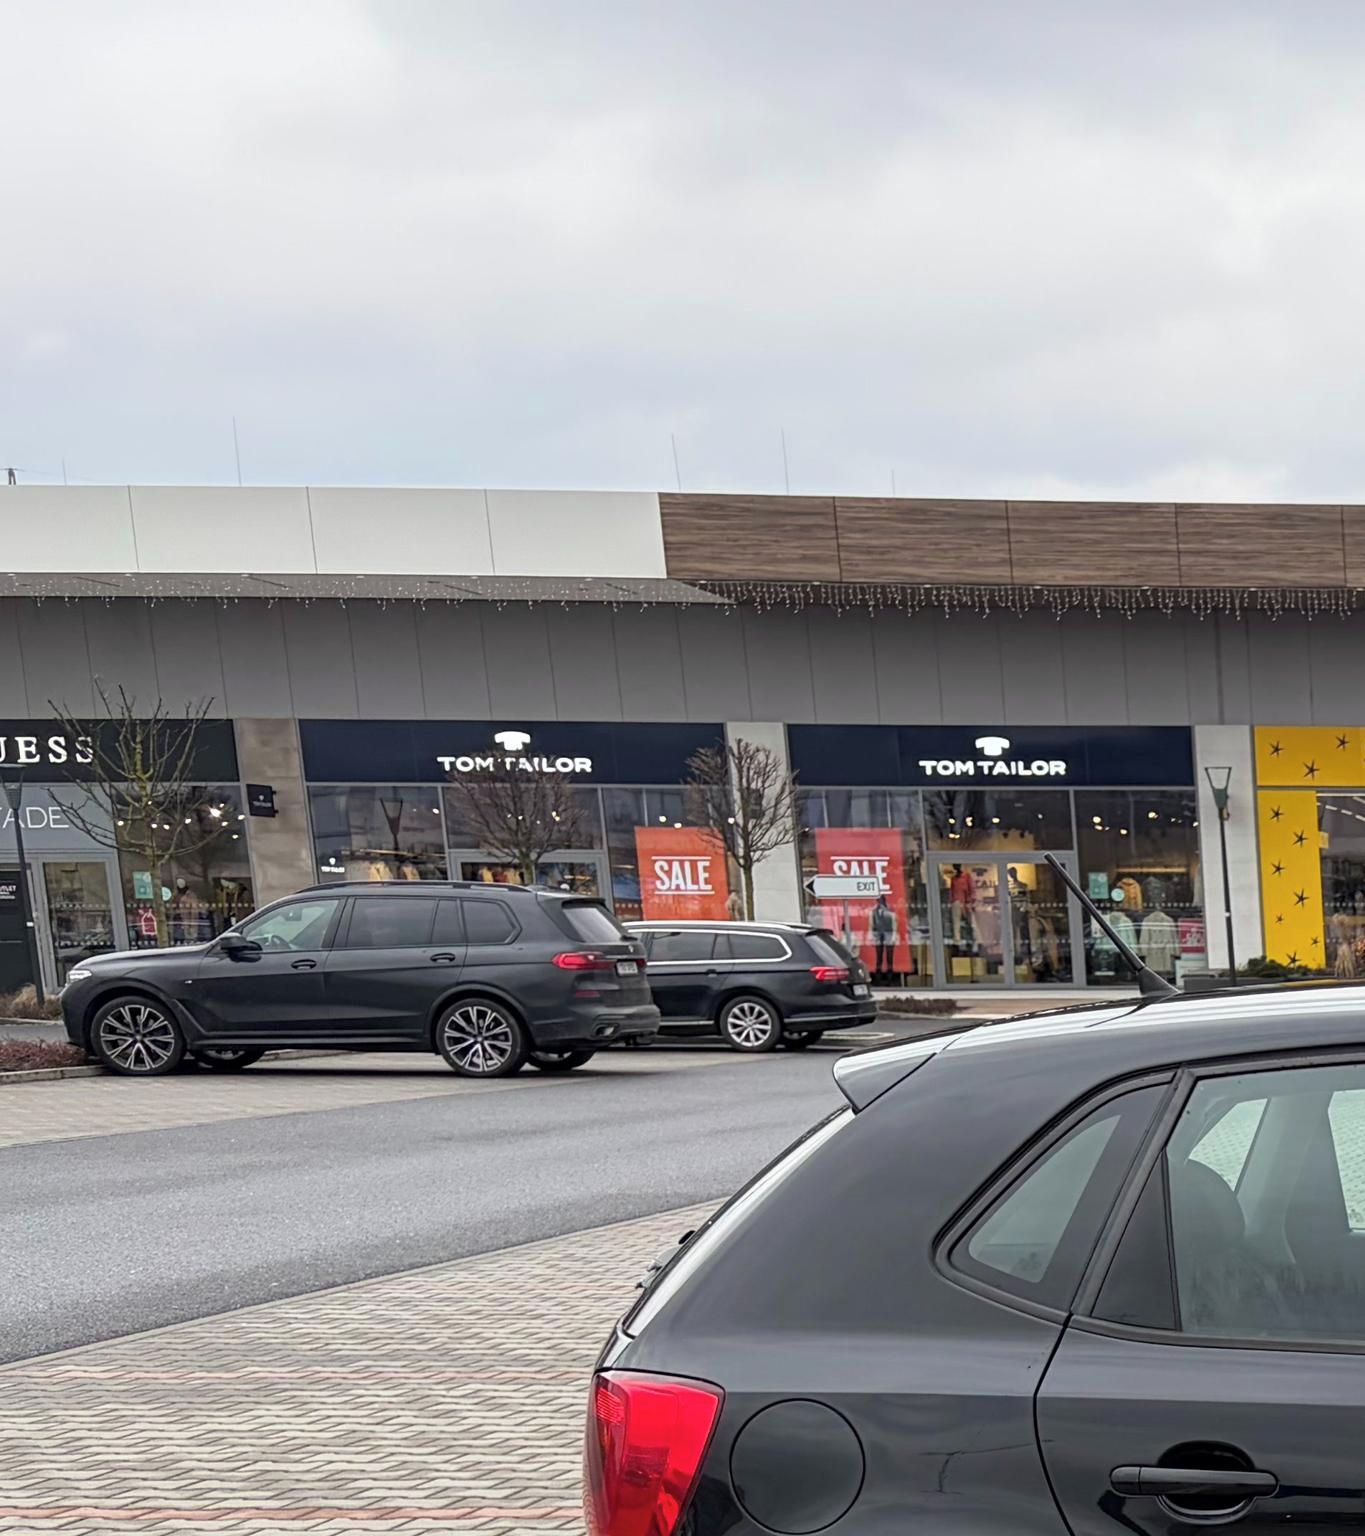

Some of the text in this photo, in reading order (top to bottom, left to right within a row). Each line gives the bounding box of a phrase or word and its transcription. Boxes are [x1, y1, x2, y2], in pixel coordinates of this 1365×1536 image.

[437, 756, 593, 773] TOM TAILOR
[918, 760, 1067, 776] TOM TAILOR
[654, 860, 712, 891] SALE
[857, 881, 876, 892] EXIT
